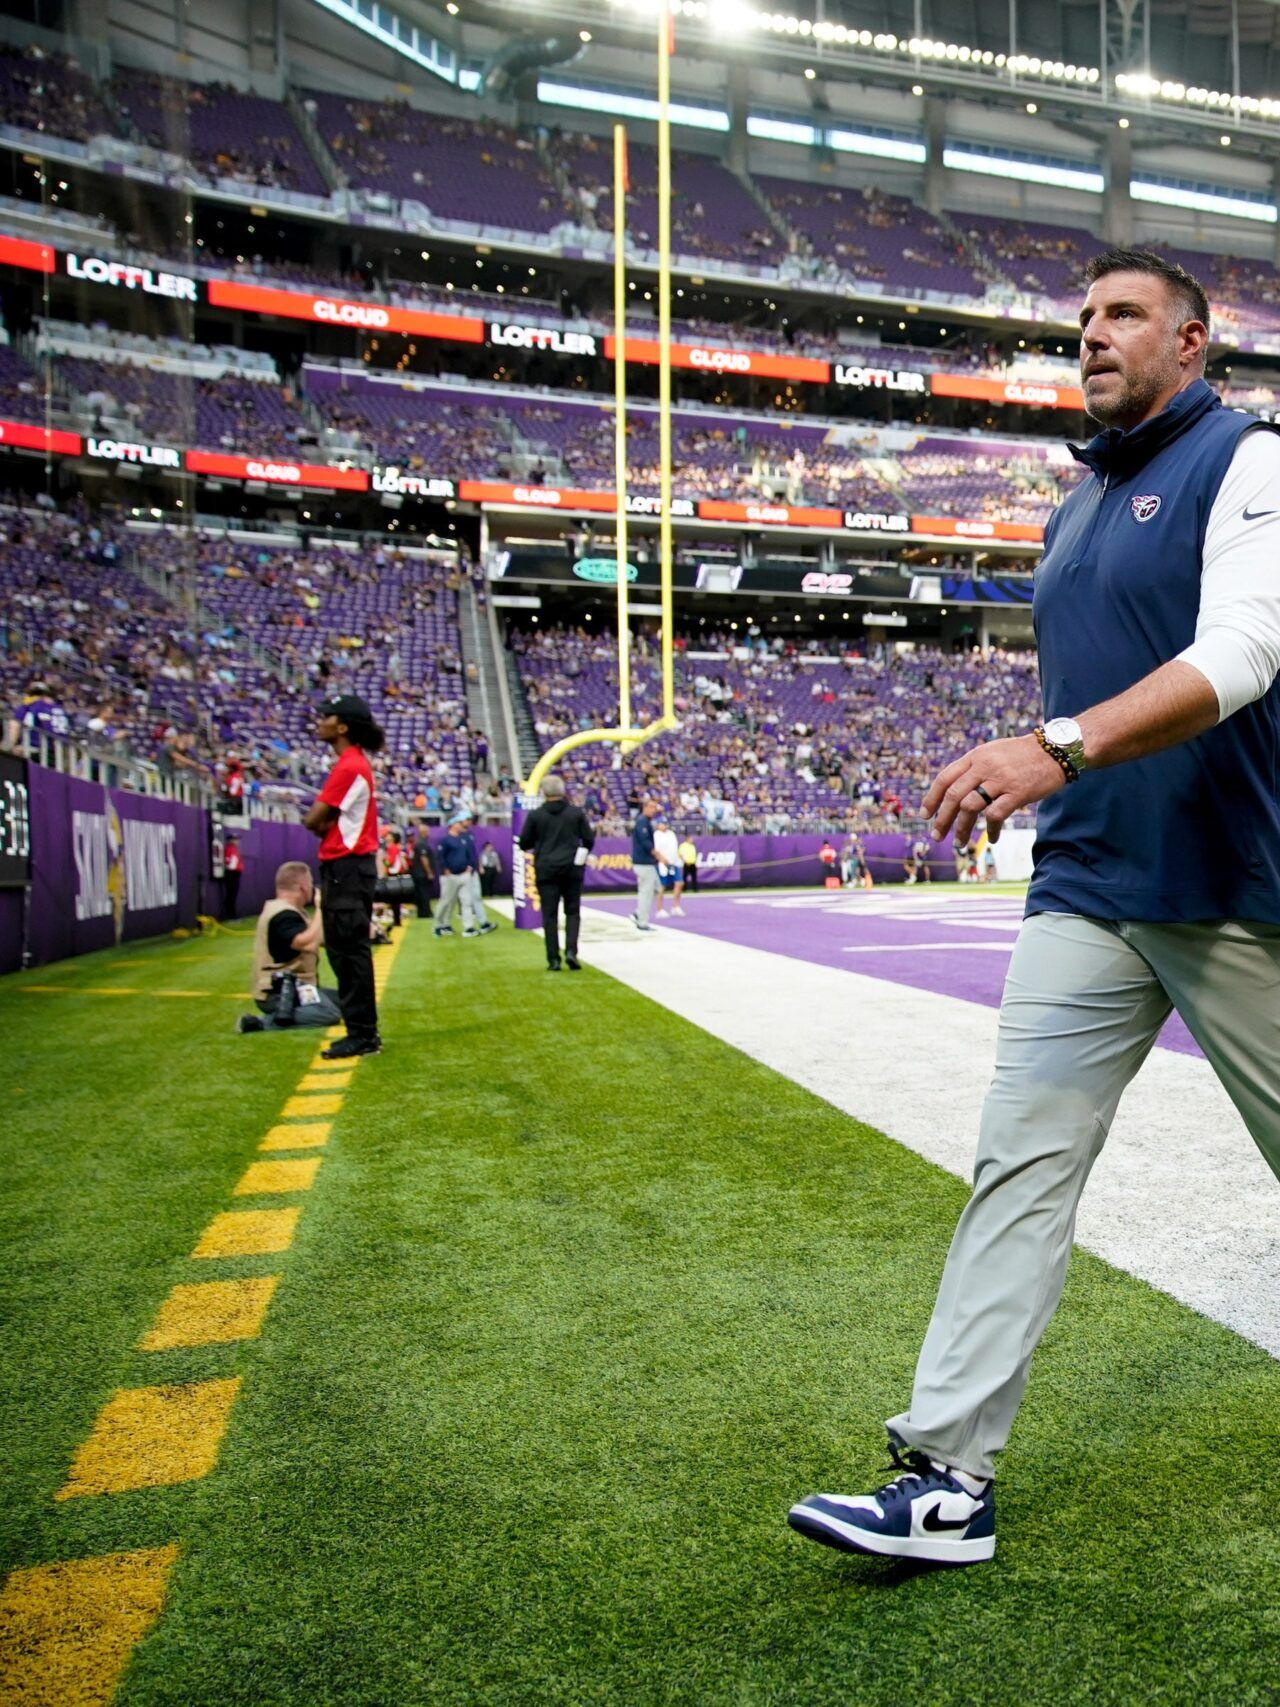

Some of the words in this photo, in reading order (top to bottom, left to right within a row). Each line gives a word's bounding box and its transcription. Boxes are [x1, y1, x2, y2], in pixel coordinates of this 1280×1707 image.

[66, 253, 197, 301] LOFFLER
[313, 300, 389, 328] CLOUD
[491, 323, 596, 356] LOFFLER
[689, 348, 751, 371] CLOUD
[835, 365, 926, 392] LOFFLER
[1004, 383, 1058, 404] CLOUD
[87, 437, 180, 468] LOFFLER
[246, 460, 300, 482] CLOUD
[372, 475, 454, 498] LOFFLER
[512, 488, 560, 505] CLOUD
[625, 495, 694, 516] LOFFER
[746, 506, 789, 522] CLOUD
[845, 513, 908, 532] LOFFLER
[955, 521, 994, 537] CLOUD
